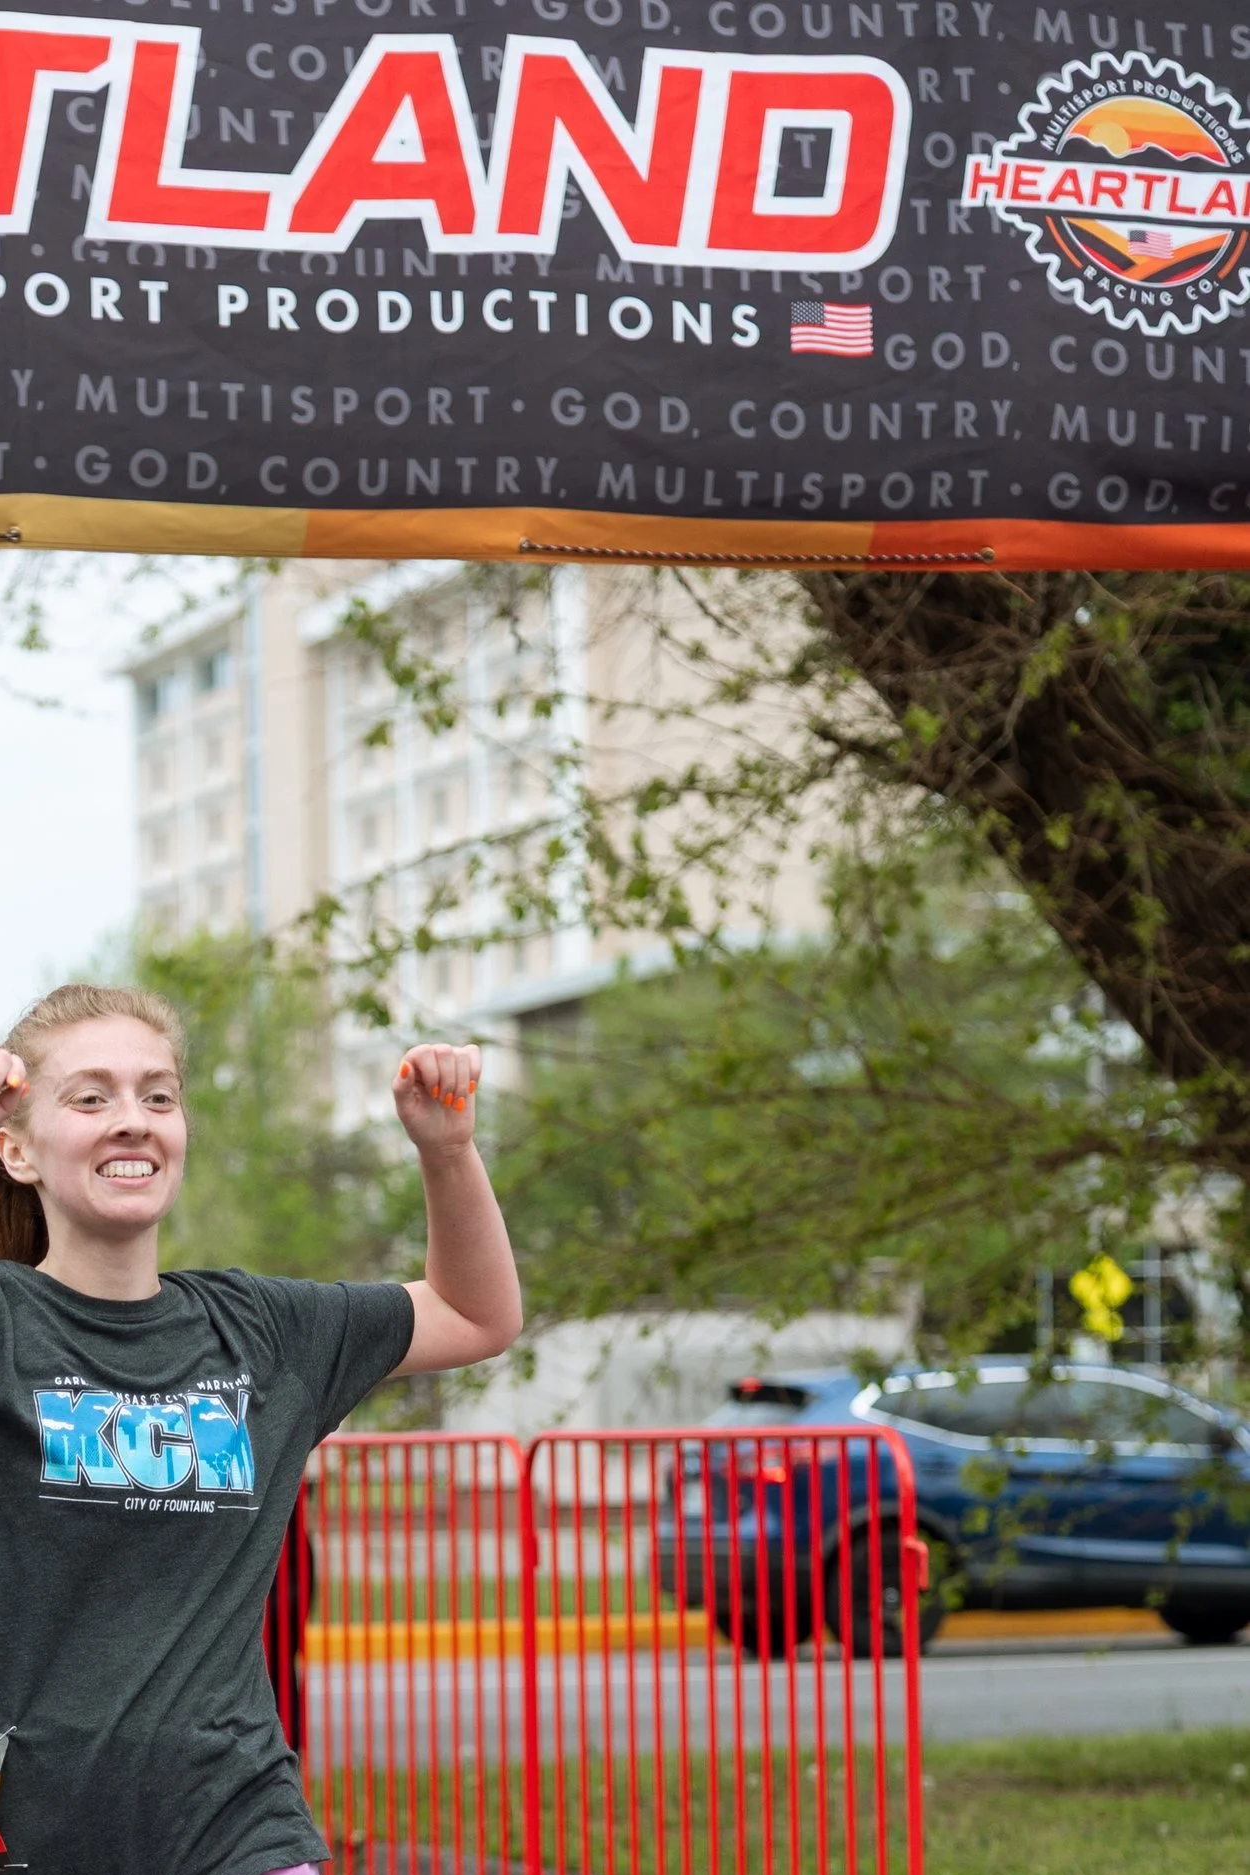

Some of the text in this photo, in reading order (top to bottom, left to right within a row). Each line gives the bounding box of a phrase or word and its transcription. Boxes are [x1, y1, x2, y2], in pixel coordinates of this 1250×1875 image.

[708, 2, 1005, 42] COUNTRY,
[1040, 78, 1127, 151] MULTISPORT
[1133, 78, 1246, 165] PRODUCTIONS
[969, 161, 1250, 217] HEARTLA
[1083, 264, 1174, 307] RACING
[217, 282, 761, 349] PRODUCTIONS
[884, 330, 1021, 373] GOD,
[75, 374, 491, 427] MULTISPORT
[550, 386, 701, 439] GOD,
[729, 399, 1023, 442] COUNTRY,
[1052, 402, 1250, 454] MULTI
[74, 448, 228, 496] GOD,
[259, 456, 568, 499] COUNTRY,
[596, 461, 990, 512] MULTISPORT
[1049, 471, 1181, 516] GOD,
[124, 1497, 216, 1513] CITY OF FOUNTAINS
